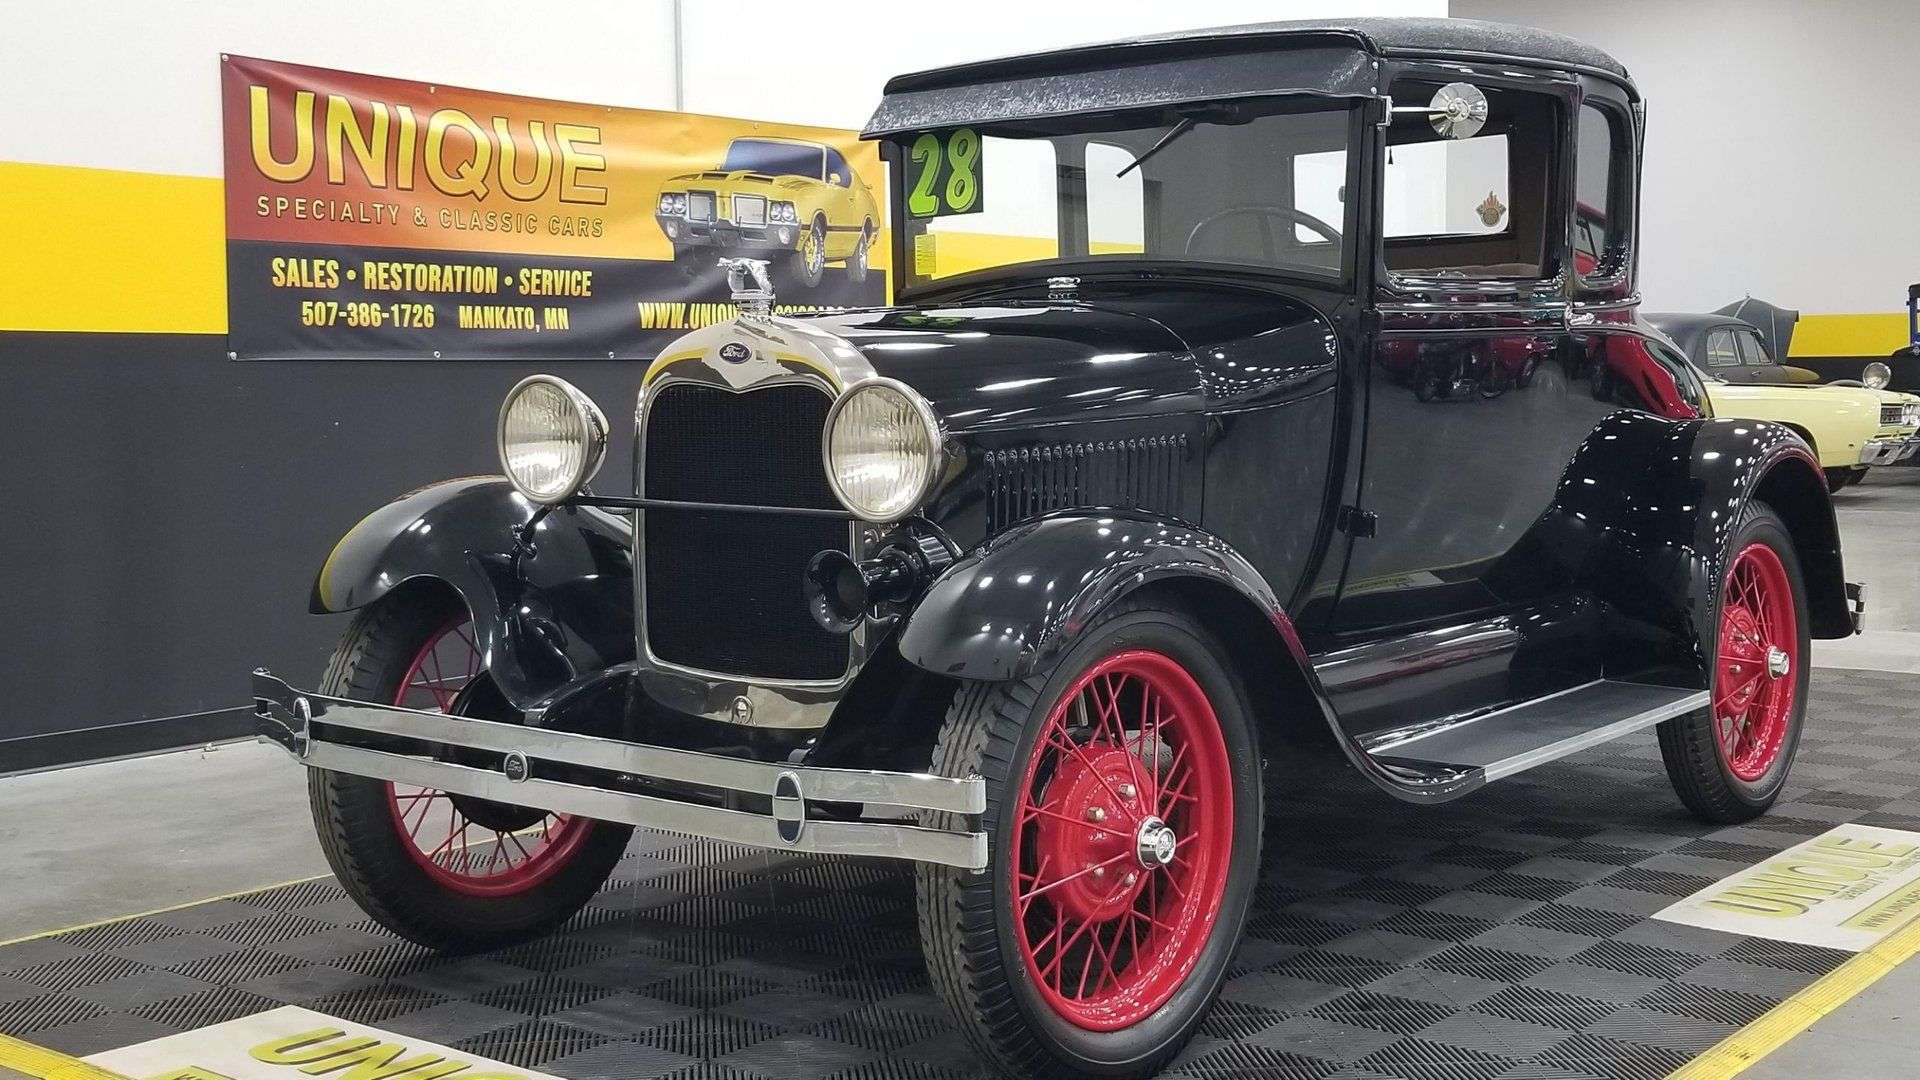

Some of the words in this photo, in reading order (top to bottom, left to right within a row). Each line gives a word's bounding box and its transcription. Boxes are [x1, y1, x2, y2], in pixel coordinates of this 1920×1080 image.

[248, 85, 608, 205] UNIQUE
[909, 128, 981, 218] 28
[257, 195, 400, 226] SPECIALTY
[412, 205, 428, 228] &
[439, 207, 538, 234] CLASSIC
[549, 215, 604, 238] CARS
[271, 256, 341, 290] SALES
[363, 260, 499, 294] RESTORATION
[518, 267, 593, 298] SERVICE
[301, 300, 435, 329] 507-386-1726
[458, 304, 541, 333] MANKATO,
[544, 306, 570, 331] MN
[721, 344, 747, 359] Ford
[1705, 834, 1919, 919] UNIQUE
[248, 1026, 532, 1080] UNI
